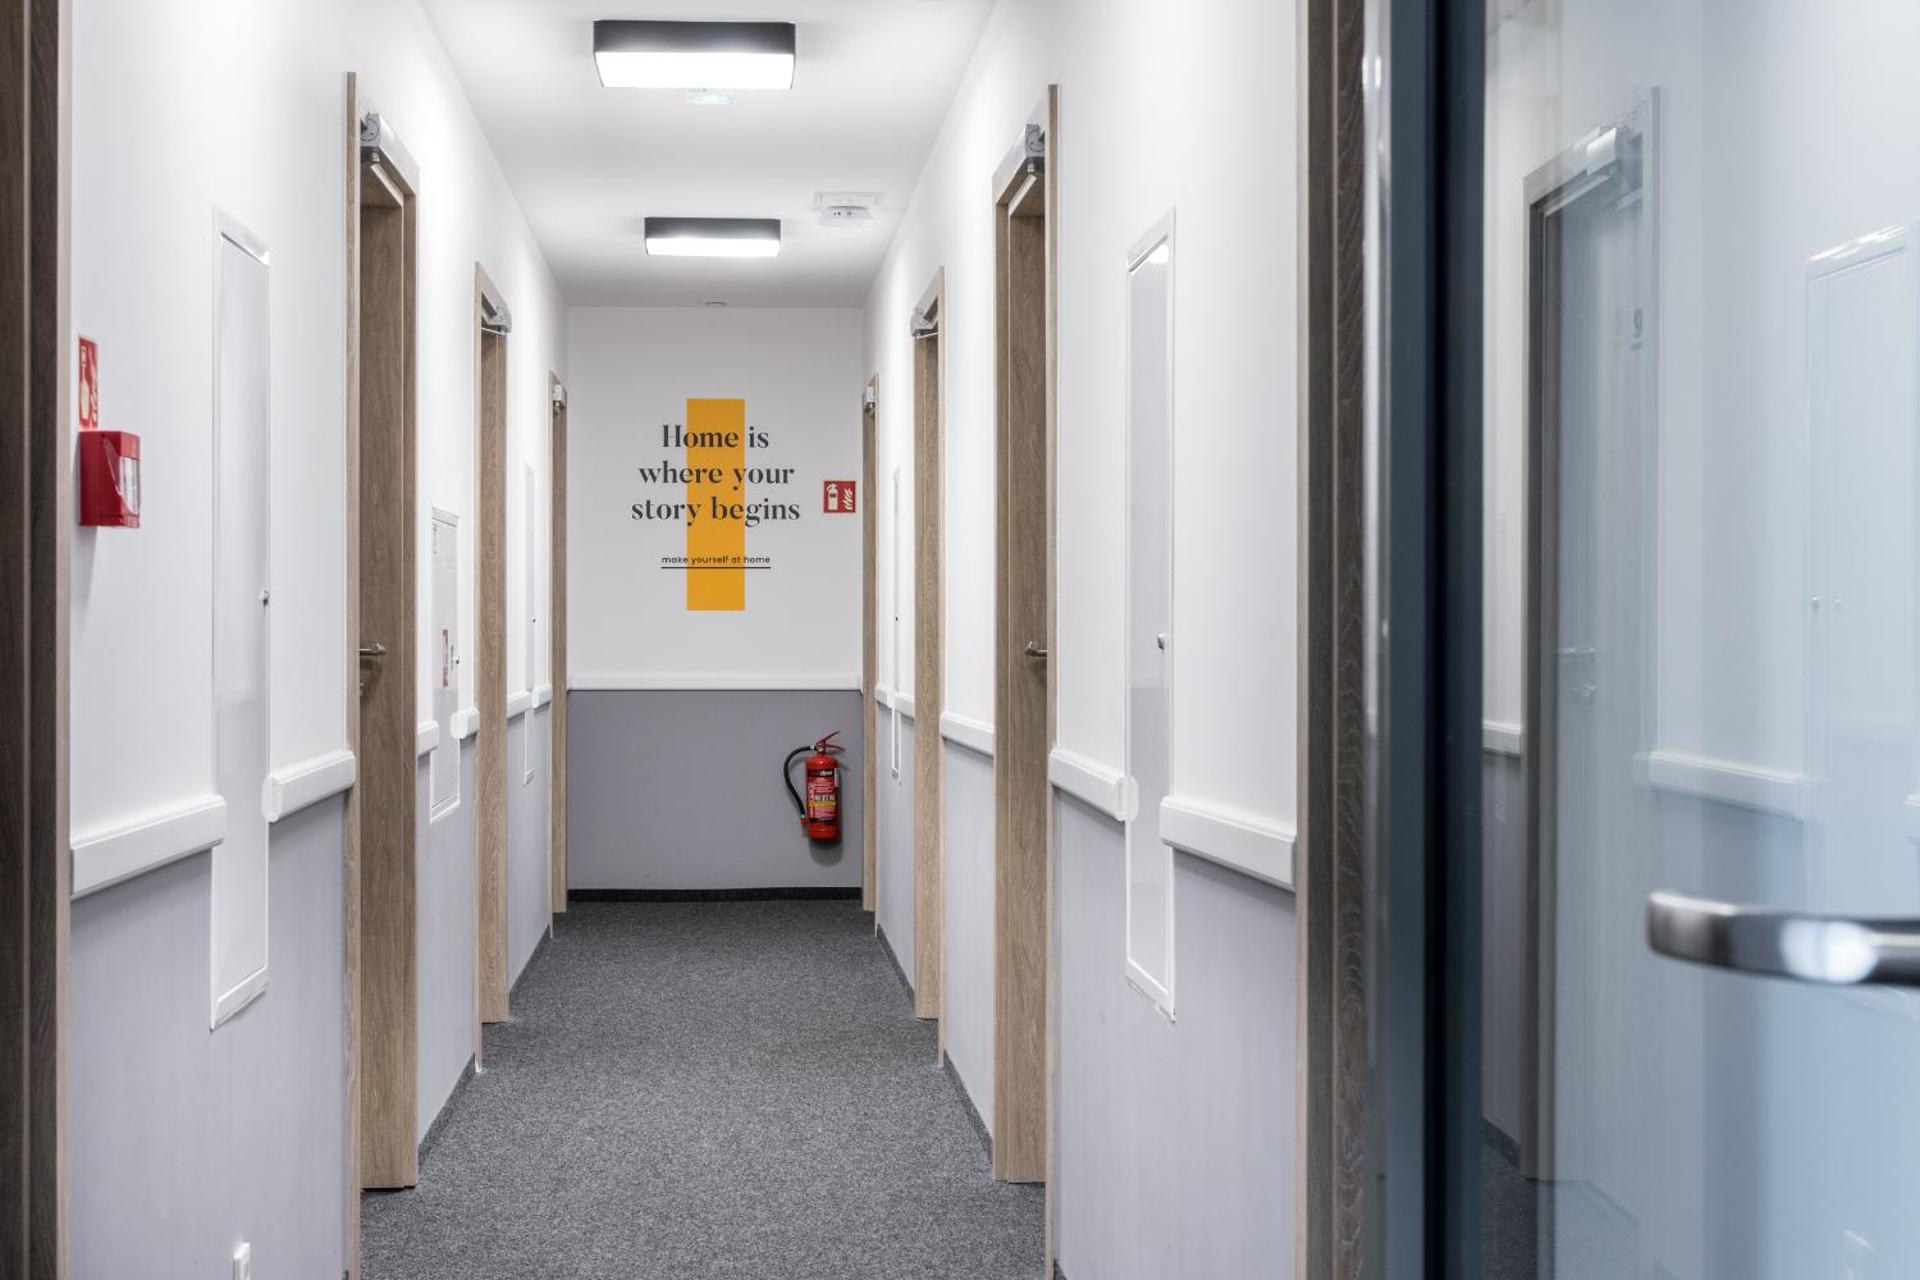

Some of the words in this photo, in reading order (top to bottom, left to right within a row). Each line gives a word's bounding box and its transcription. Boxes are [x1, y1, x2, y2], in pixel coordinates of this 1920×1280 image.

[662, 424, 739, 449] Home
[748, 425, 770, 449] is
[638, 459, 723, 484] where
[732, 468, 795, 491] your
[631, 499, 701, 527] story
[711, 495, 801, 528] begins
[661, 556, 689, 564] make
[691, 555, 729, 566] yourself
[731, 556, 742, 564] at
[743, 556, 771, 564] home
